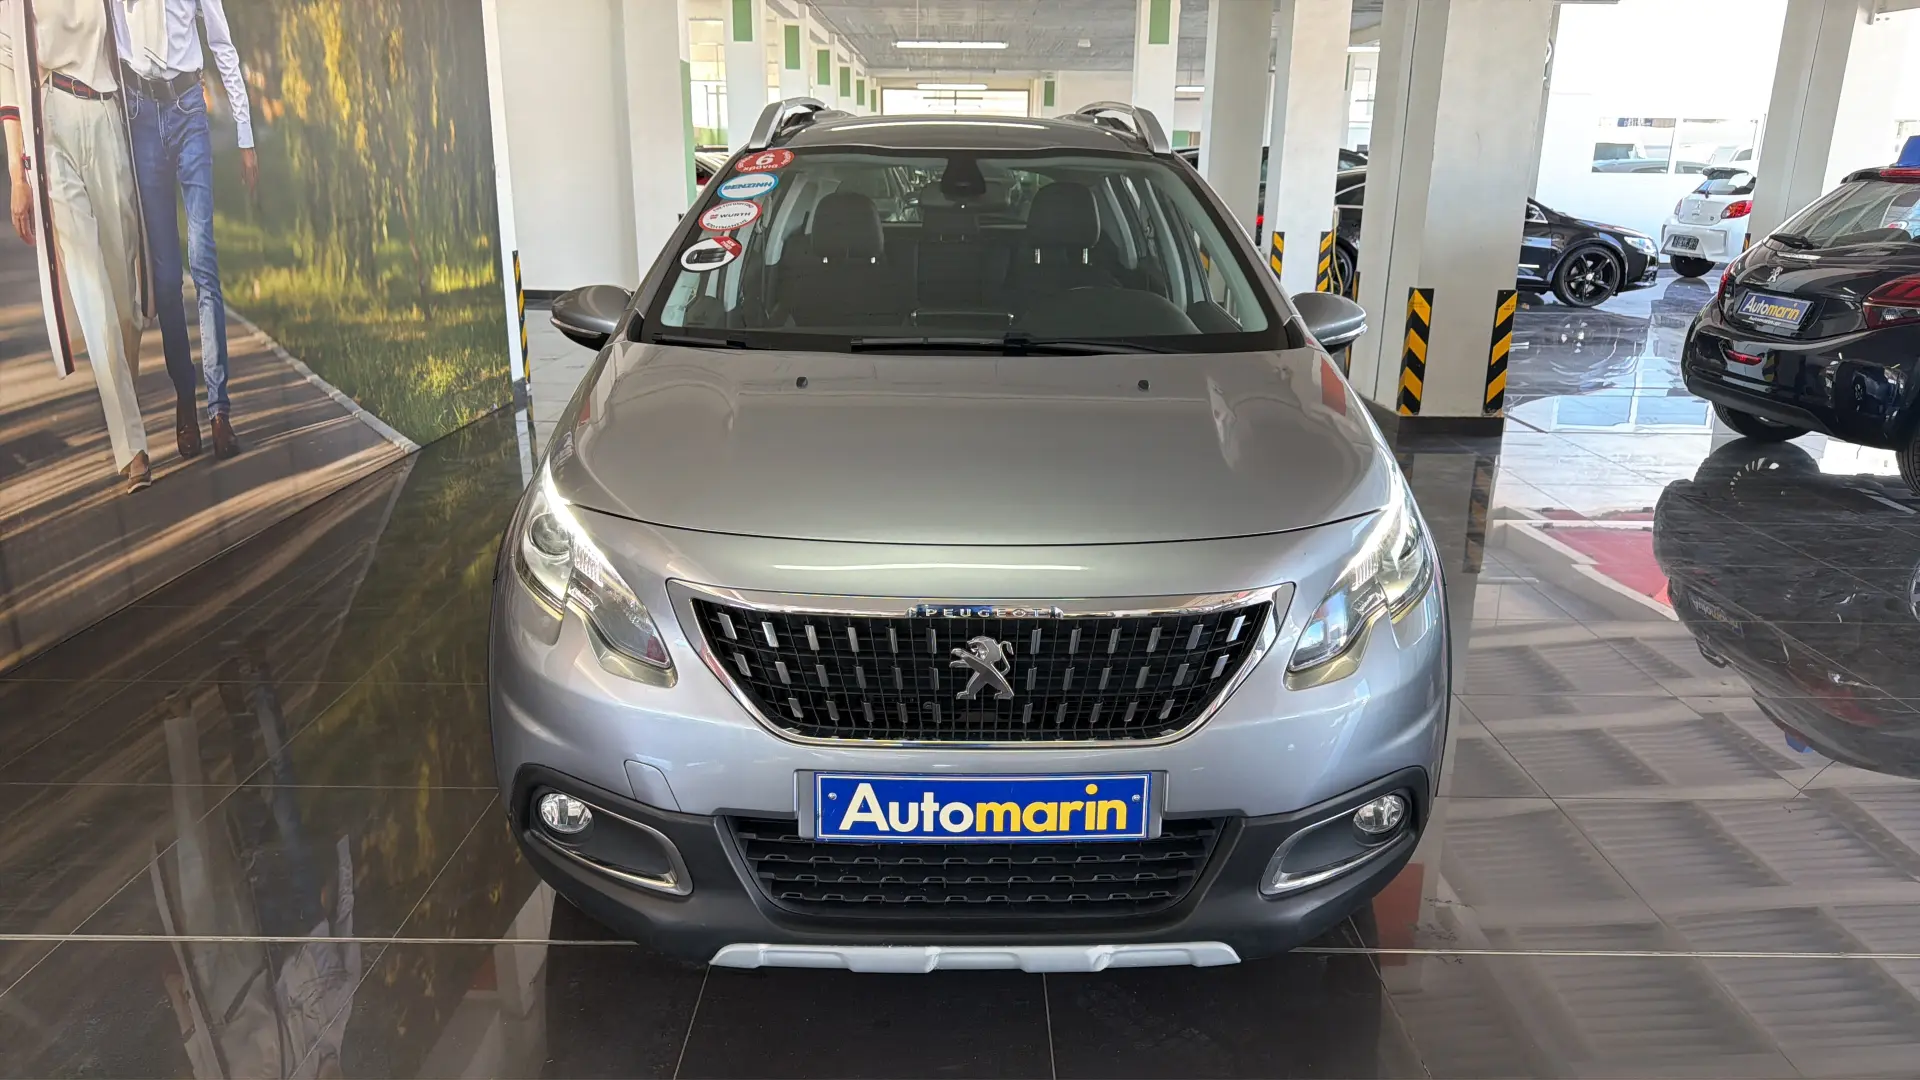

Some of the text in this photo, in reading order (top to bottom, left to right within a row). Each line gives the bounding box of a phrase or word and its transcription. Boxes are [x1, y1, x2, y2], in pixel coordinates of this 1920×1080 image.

[756, 153, 775, 165] 6
[1743, 296, 1800, 320] Automarin
[925, 608, 1043, 617] PEUGEOT
[838, 782, 1127, 833] Automarin
